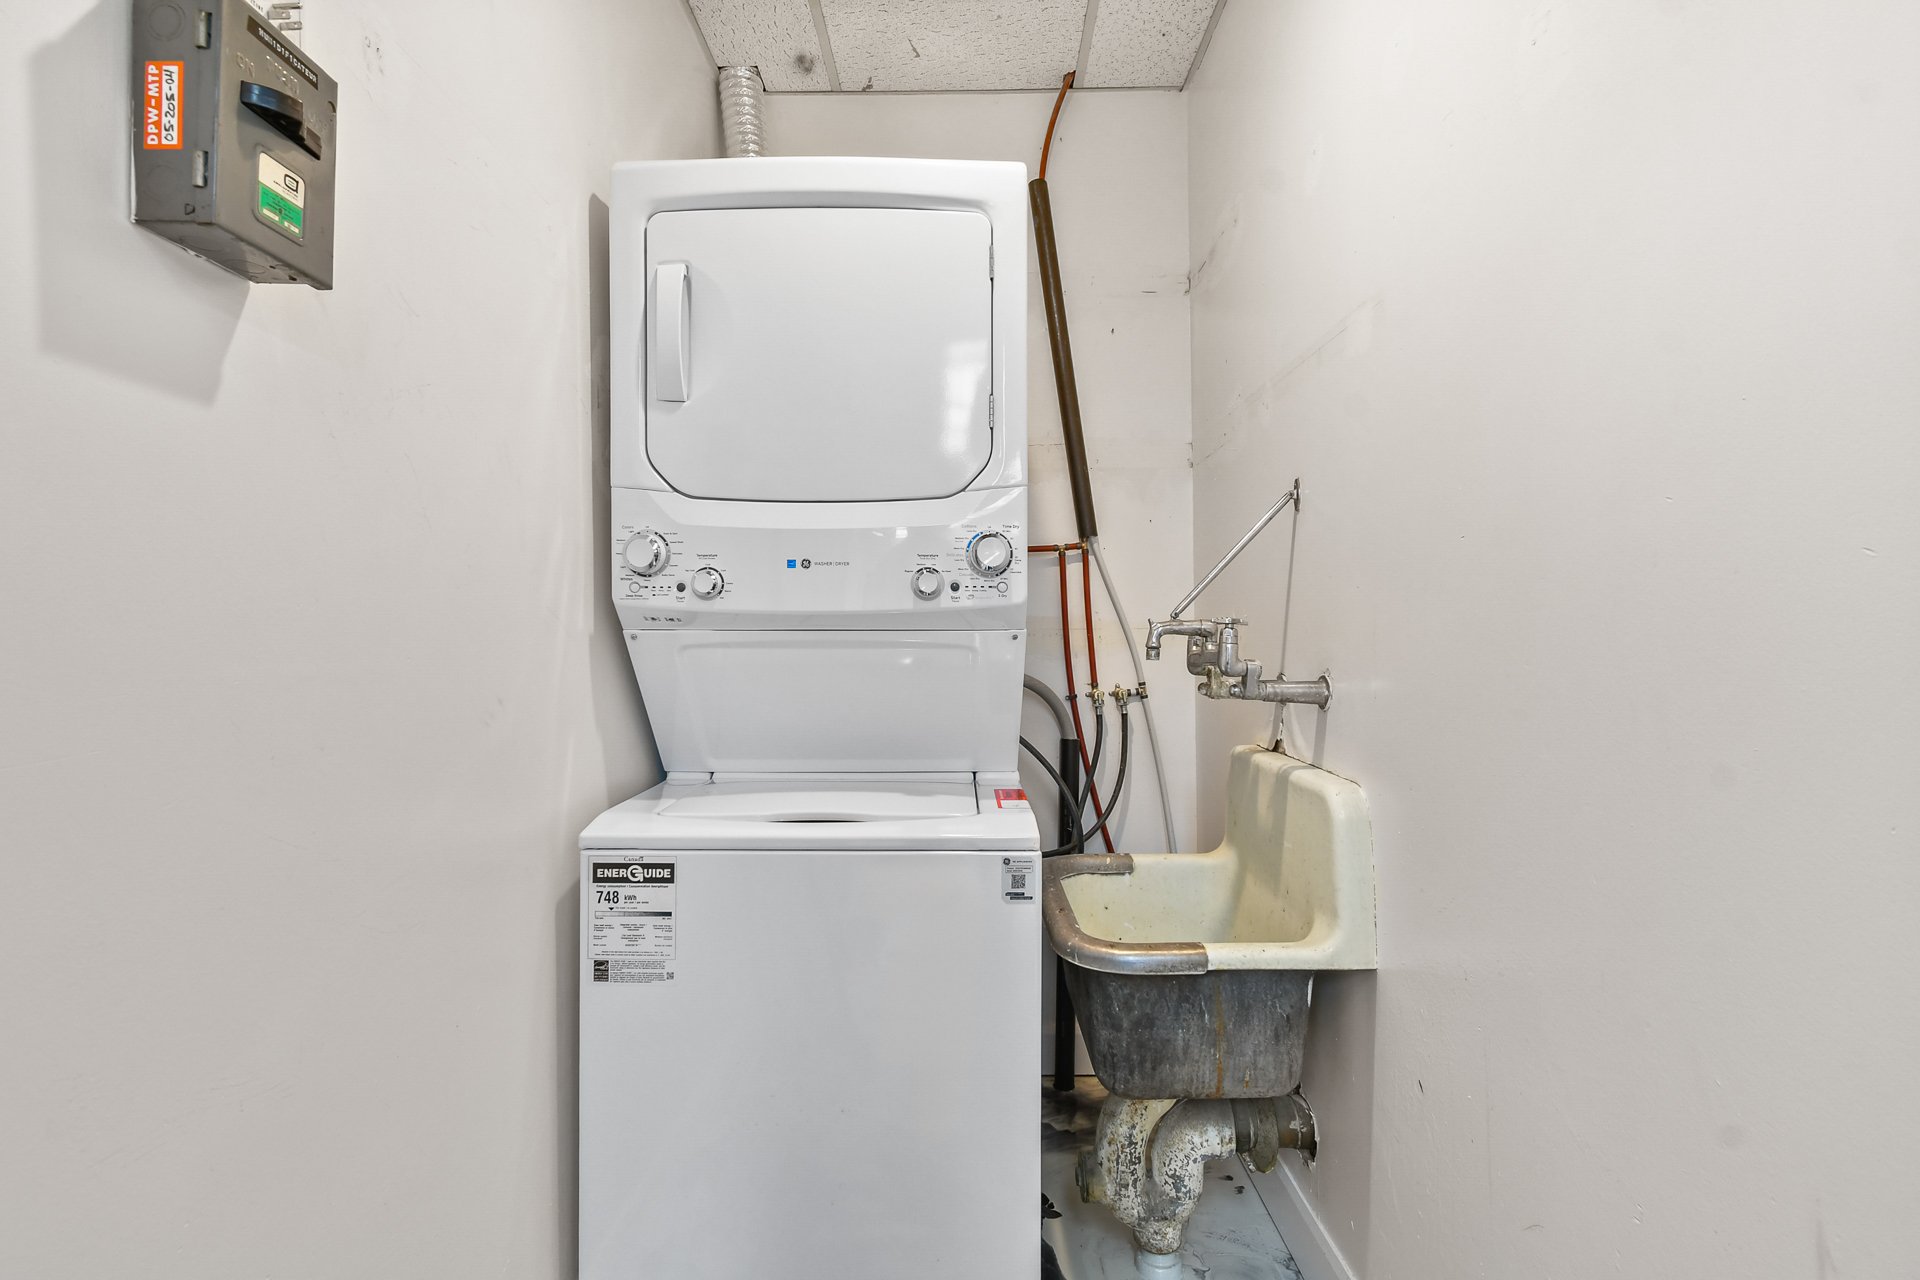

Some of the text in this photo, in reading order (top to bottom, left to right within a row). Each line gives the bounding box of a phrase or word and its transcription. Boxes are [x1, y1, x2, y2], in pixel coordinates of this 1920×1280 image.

[147, 64, 160, 145] DPW-MTP
[163, 69, 176, 142] 05-205-04
[596, 864, 672, 882] ENERGUIDE
[596, 890, 620, 904] 748
